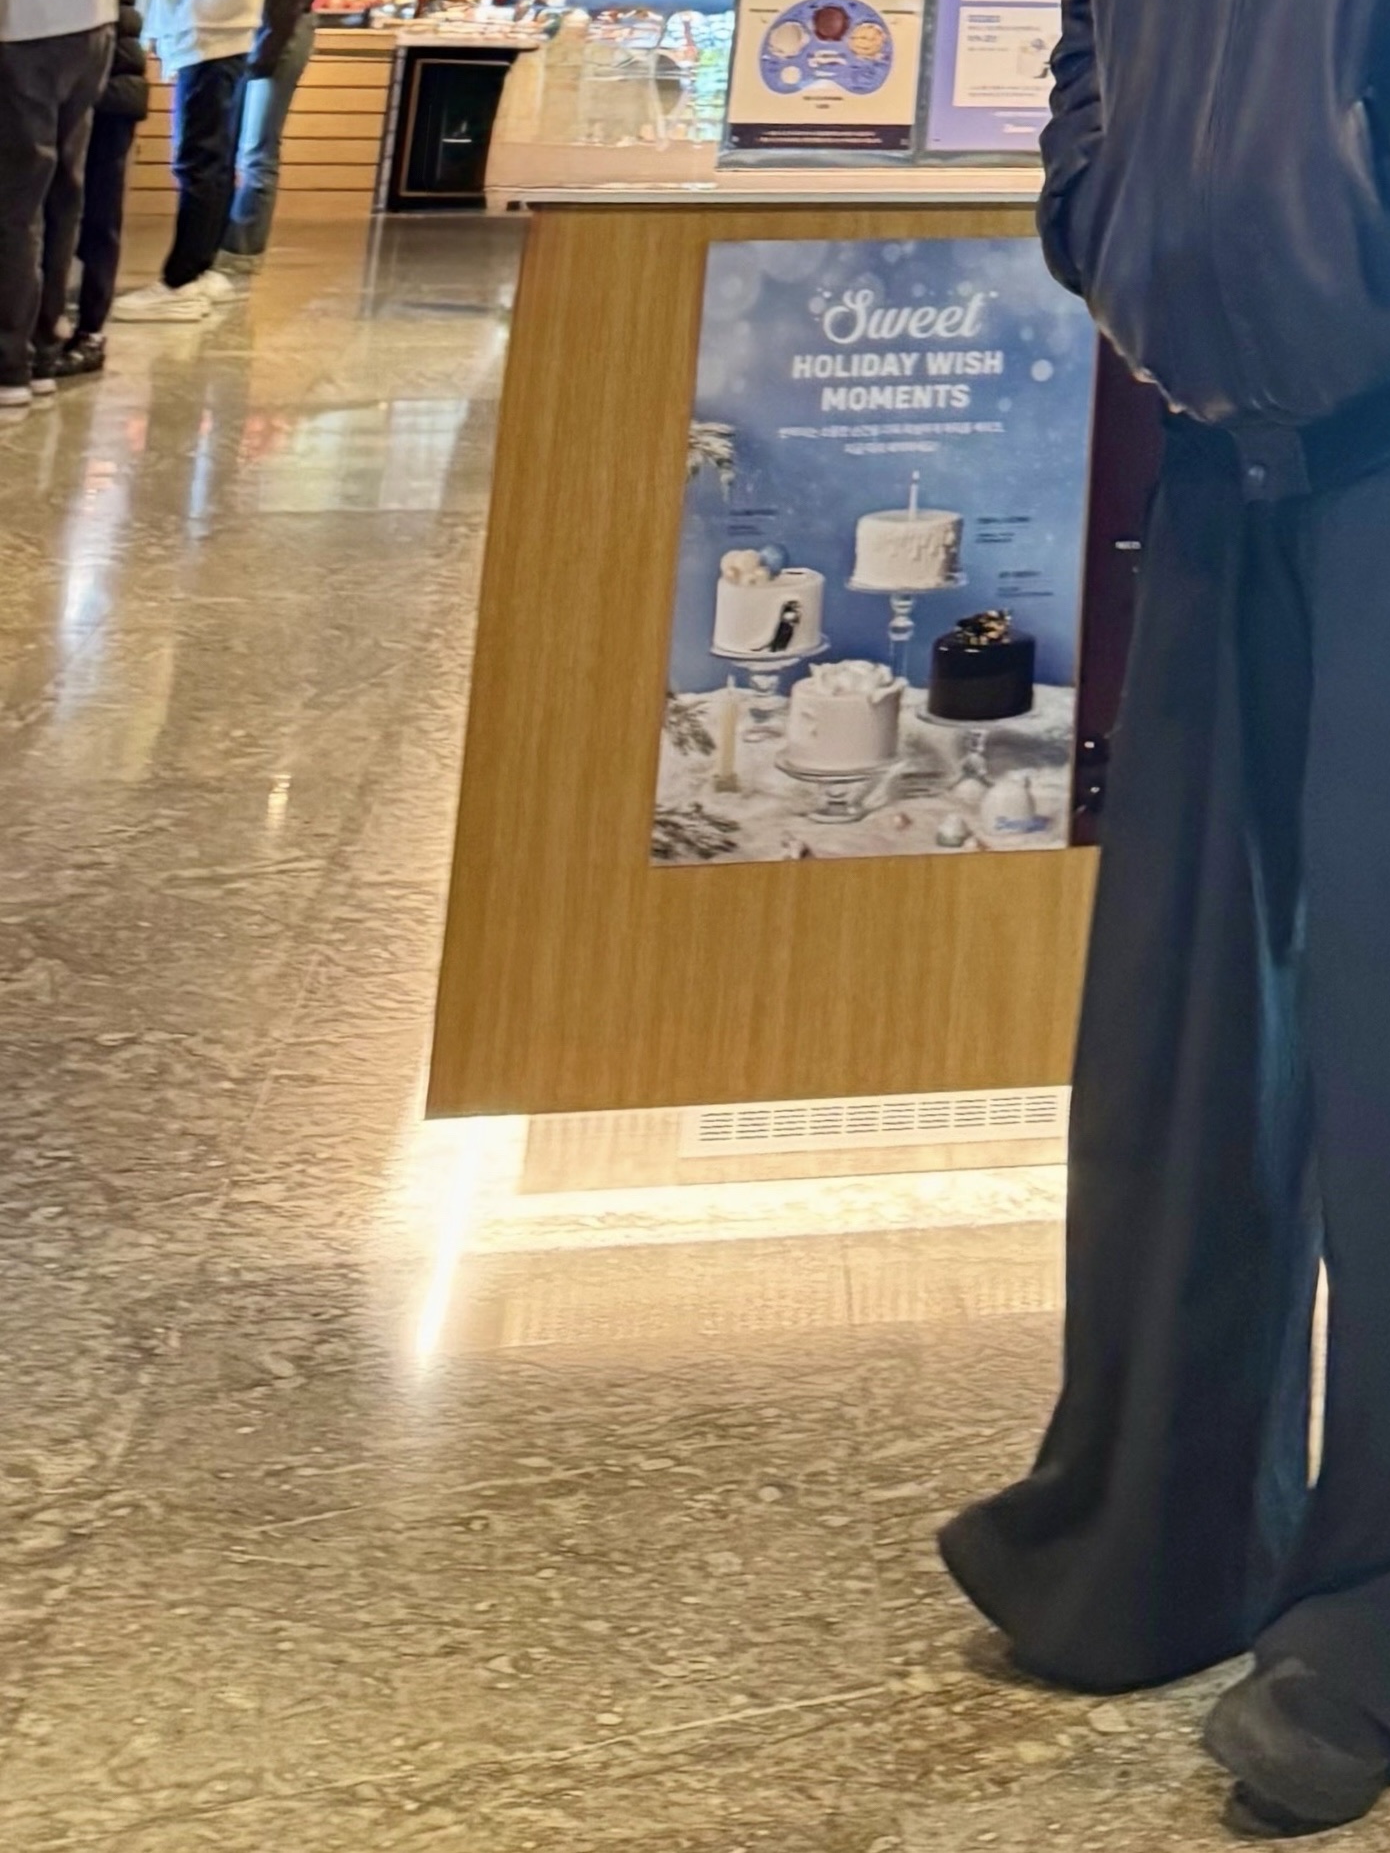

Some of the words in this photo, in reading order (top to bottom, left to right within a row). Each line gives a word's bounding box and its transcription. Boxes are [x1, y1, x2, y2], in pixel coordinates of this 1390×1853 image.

[822, 288, 985, 345] Sweet
[791, 352, 921, 379] HOLIDAY
[925, 350, 1005, 377] WISH
[820, 383, 972, 412] MOMENTS
